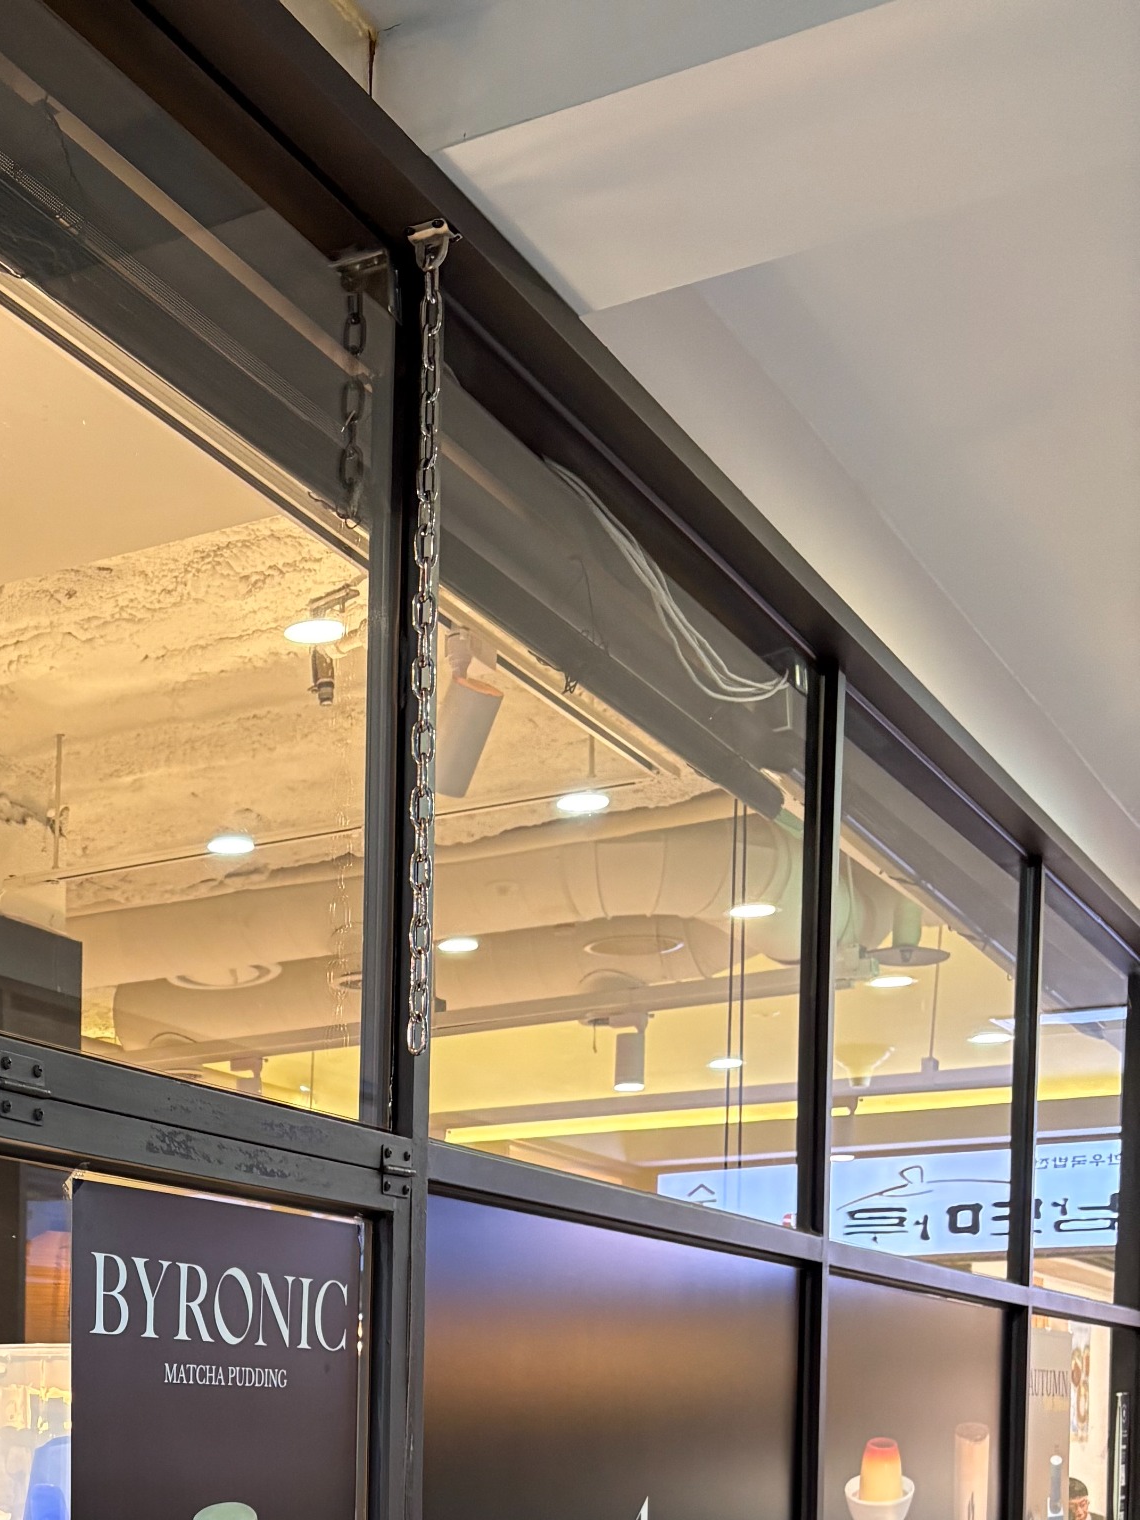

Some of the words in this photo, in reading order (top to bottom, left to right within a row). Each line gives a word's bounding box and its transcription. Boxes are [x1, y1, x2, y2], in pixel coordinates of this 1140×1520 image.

[89, 1251, 349, 1352] BYRONIC
[163, 1362, 226, 1387] MATCHA
[227, 1365, 288, 1388] PUDDING
[1028, 1368, 1069, 1398] AUTUMN
